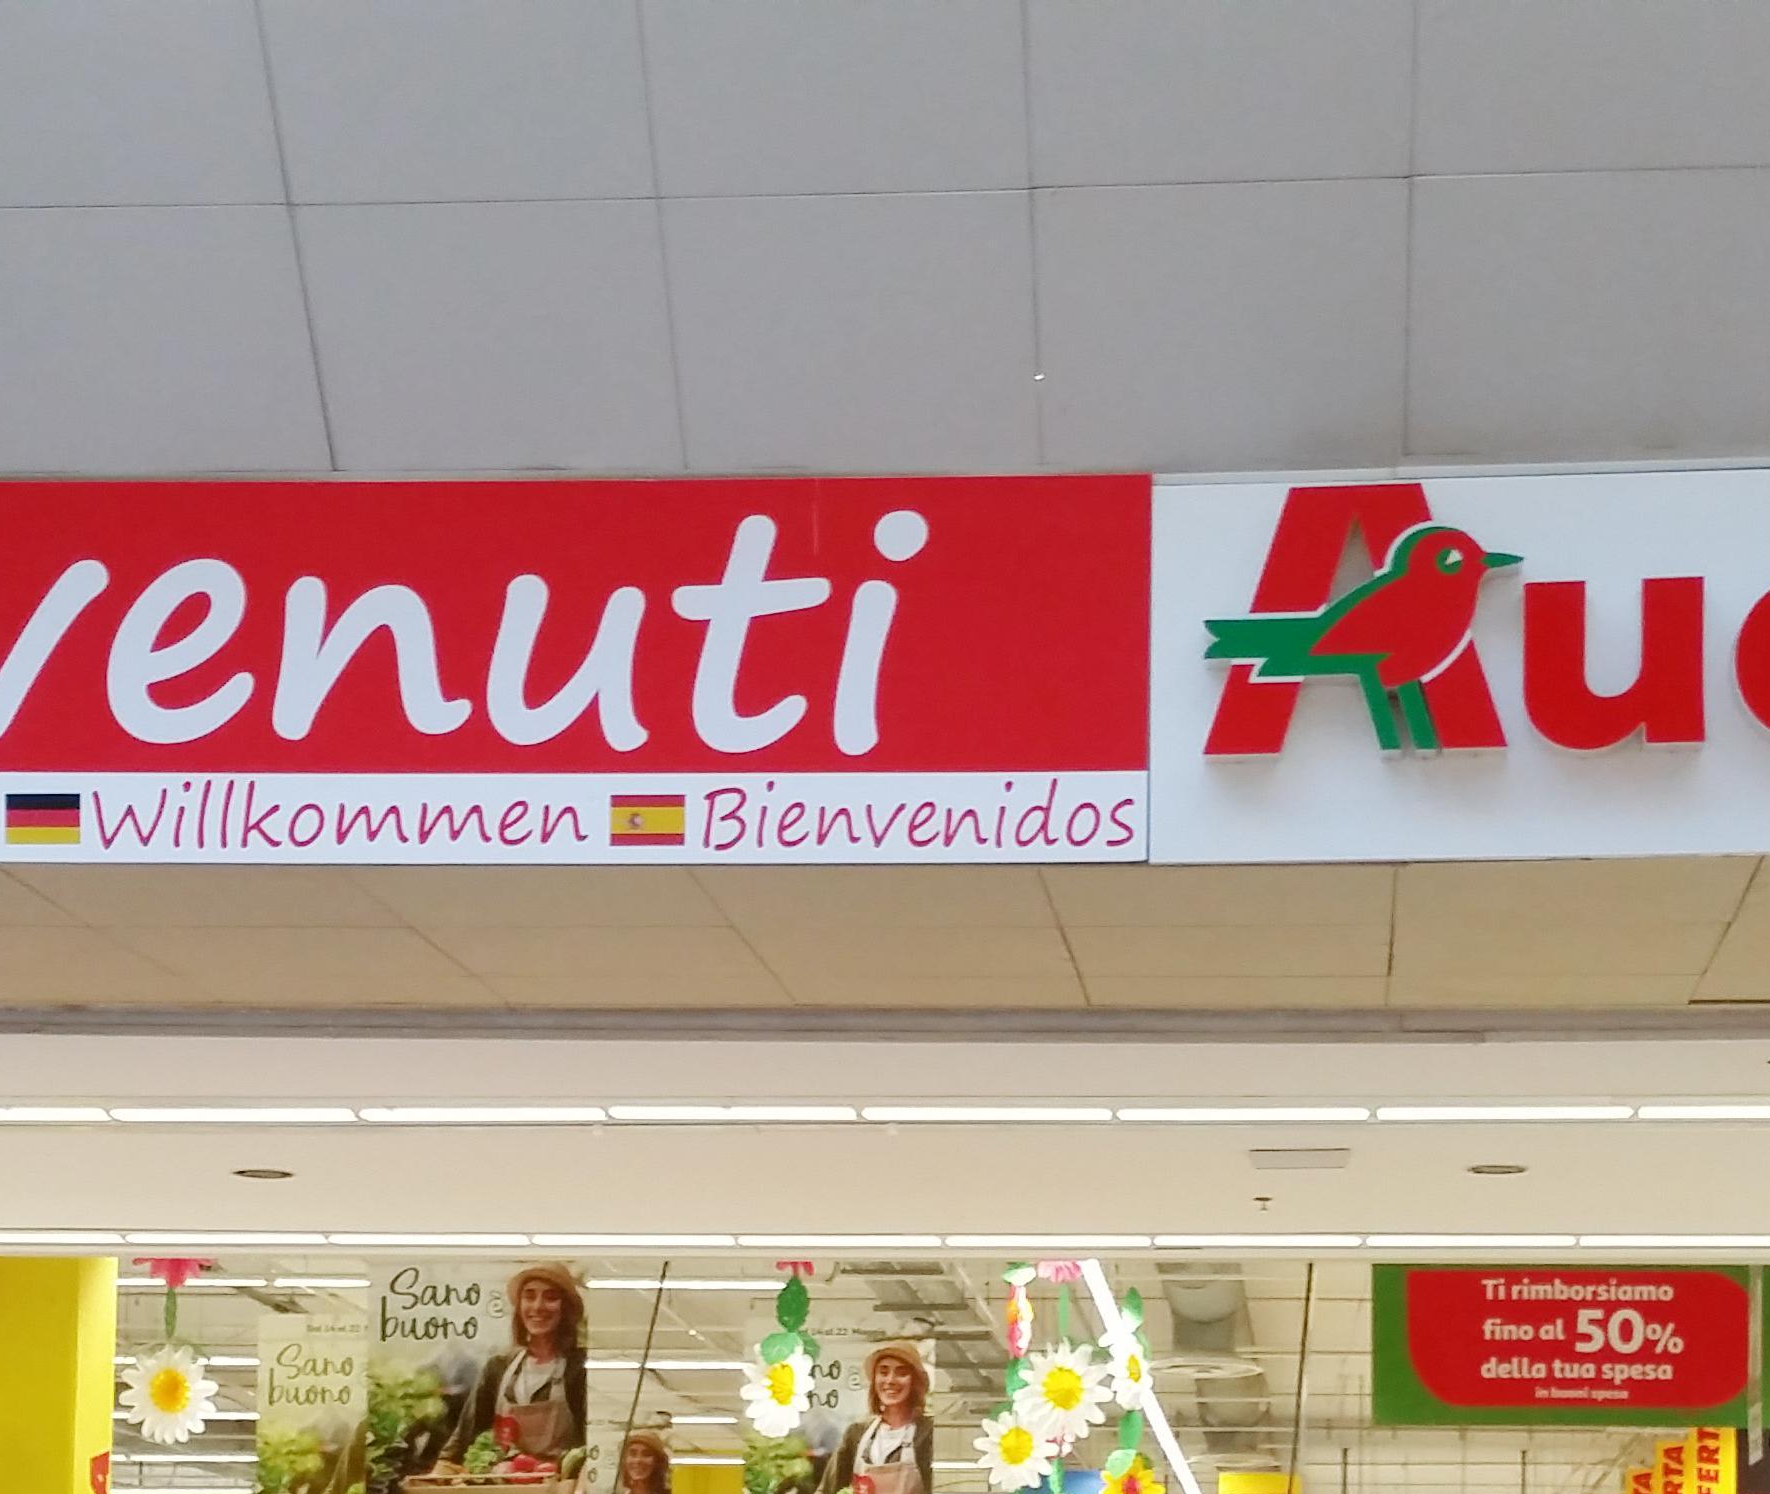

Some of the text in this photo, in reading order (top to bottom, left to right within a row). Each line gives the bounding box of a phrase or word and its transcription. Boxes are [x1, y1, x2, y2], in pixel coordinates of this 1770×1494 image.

[89, 777, 588, 850] Willkommen
[701, 777, 1136, 851] Bienvenidos
[390, 1267, 480, 1310] Sano
[1481, 1278, 1674, 1301] Ti rimborsiamo
[381, 1295, 478, 1342] buono
[1482, 1308, 1685, 1354] fino al 50%
[275, 1343, 355, 1379] Sano
[809, 1360, 841, 1380] no
[1481, 1357, 1674, 1386] della tua spesa
[268, 1367, 351, 1407] buono
